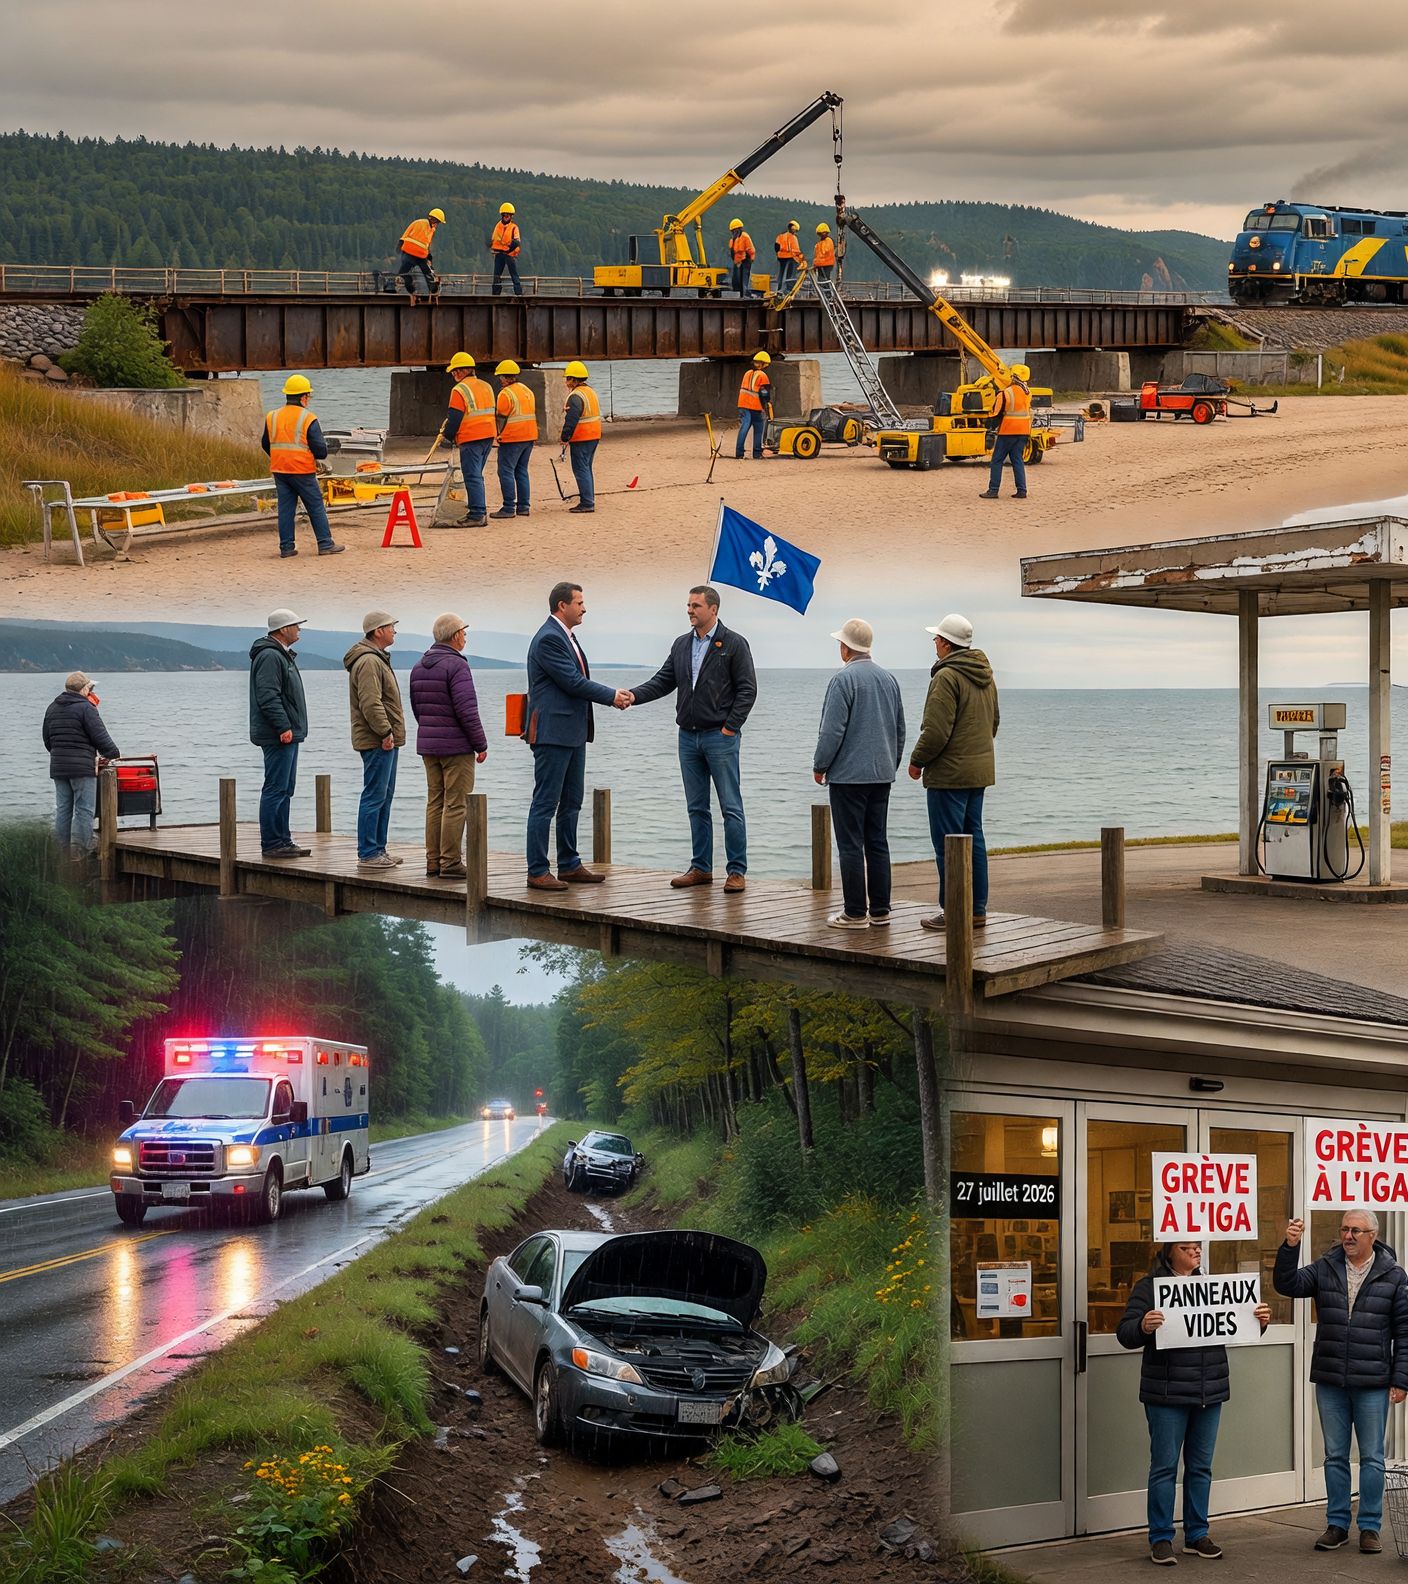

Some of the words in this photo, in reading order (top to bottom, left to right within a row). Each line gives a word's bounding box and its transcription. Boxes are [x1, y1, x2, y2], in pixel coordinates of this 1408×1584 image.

[1161, 1154, 1250, 1194] GRÈVE
[1312, 1163, 1333, 1202] À
[956, 1181, 975, 1201] 27
[977, 1181, 1020, 1206] juillet
[1022, 1184, 1055, 1203] 2026
[1160, 1195, 1179, 1233] À
[1186, 1201, 1252, 1233] L'IGA
[1159, 1279, 1258, 1308] PANNEAUX
[1183, 1311, 1238, 1338] VIDES
